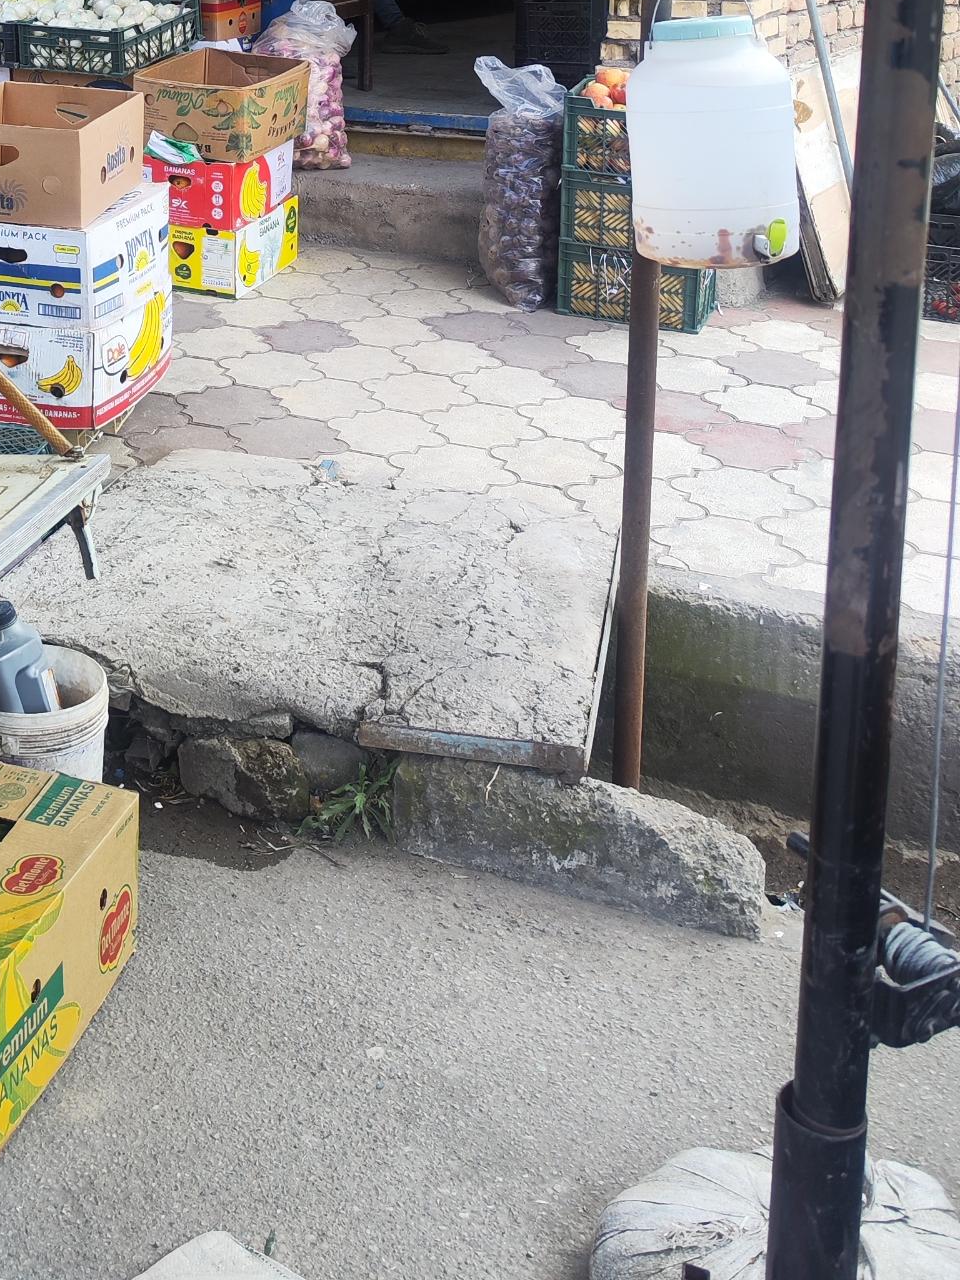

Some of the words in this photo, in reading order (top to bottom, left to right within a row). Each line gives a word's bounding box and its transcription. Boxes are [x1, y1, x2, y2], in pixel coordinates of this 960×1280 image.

[164, 165, 196, 176] BANANAS
[22, 231, 48, 241] PACK
[107, 342, 126, 363] Dole
[35, 786, 76, 825] Premium
[54, 783, 96, 828] BANANAS
[24, 857, 51, 881] Monte
